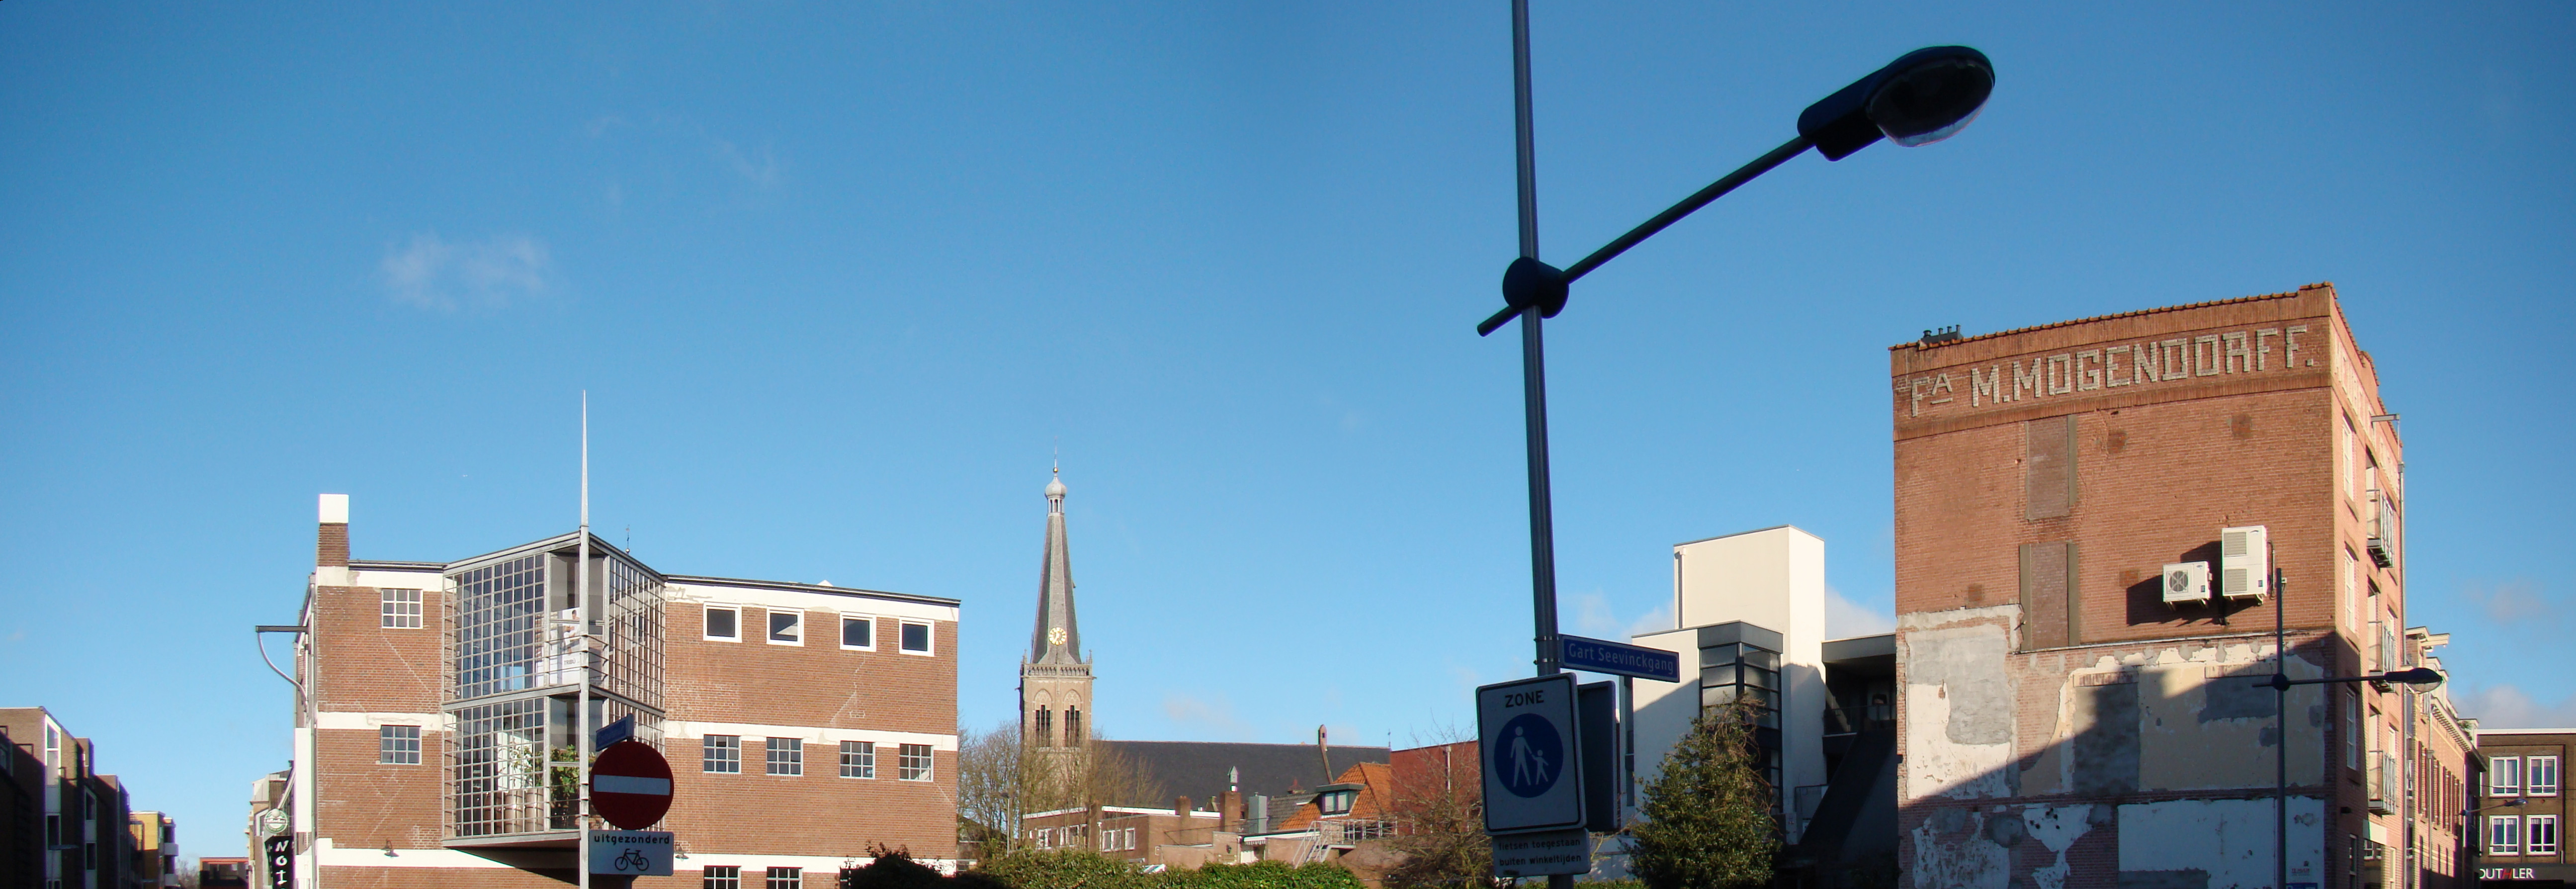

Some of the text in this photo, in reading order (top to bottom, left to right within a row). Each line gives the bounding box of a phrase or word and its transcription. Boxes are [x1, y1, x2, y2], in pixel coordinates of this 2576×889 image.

[1569, 643, 1673, 675] Gart Seevinckgang
[1505, 690, 1544, 708] ZONE
[594, 834, 670, 845] uitgezonderd
[1499, 838, 1580, 851] fietsen toegestaan
[1499, 853, 1582, 866] buiten winkeltijden
